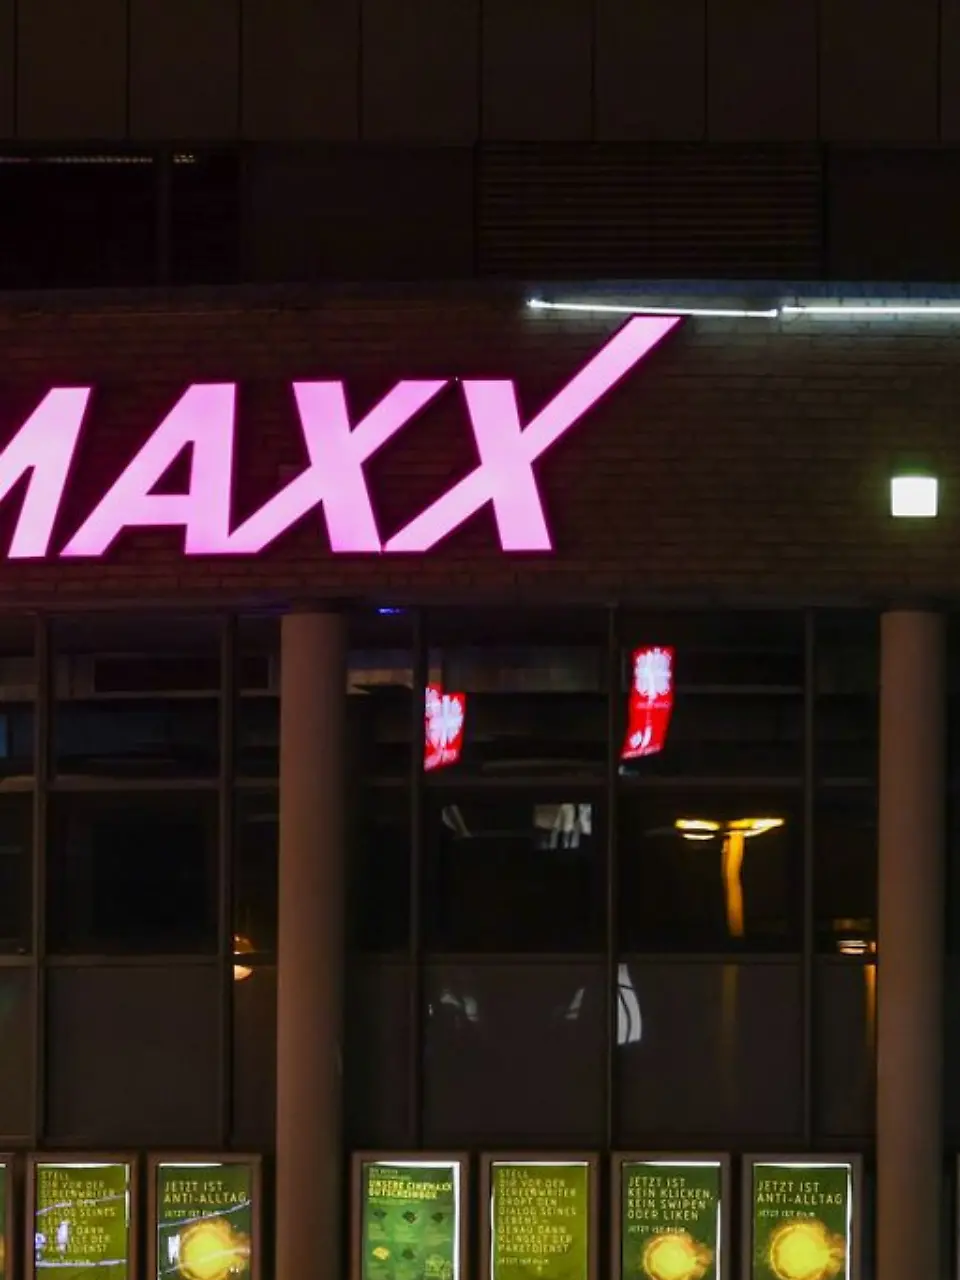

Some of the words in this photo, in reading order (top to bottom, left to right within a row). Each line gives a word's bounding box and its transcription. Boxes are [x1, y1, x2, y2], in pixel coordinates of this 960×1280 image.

[164, 1181, 198, 1192] JETZT
[204, 1181, 223, 1192] IST
[628, 1176, 661, 1187] JETZT
[667, 1177, 685, 1187] IST
[757, 1181, 794, 1192] JETZT
[800, 1181, 820, 1193] IST
[163, 1191, 247, 1204] ANTI-ALLTAG
[628, 1187, 655, 1198] KEIN
[628, 1199, 655, 1208] KEIN
[757, 1193, 842, 1205] ANTI-ALLTAG
[628, 1209, 659, 1219] ODER
[663, 1210, 699, 1221] LIKEN
